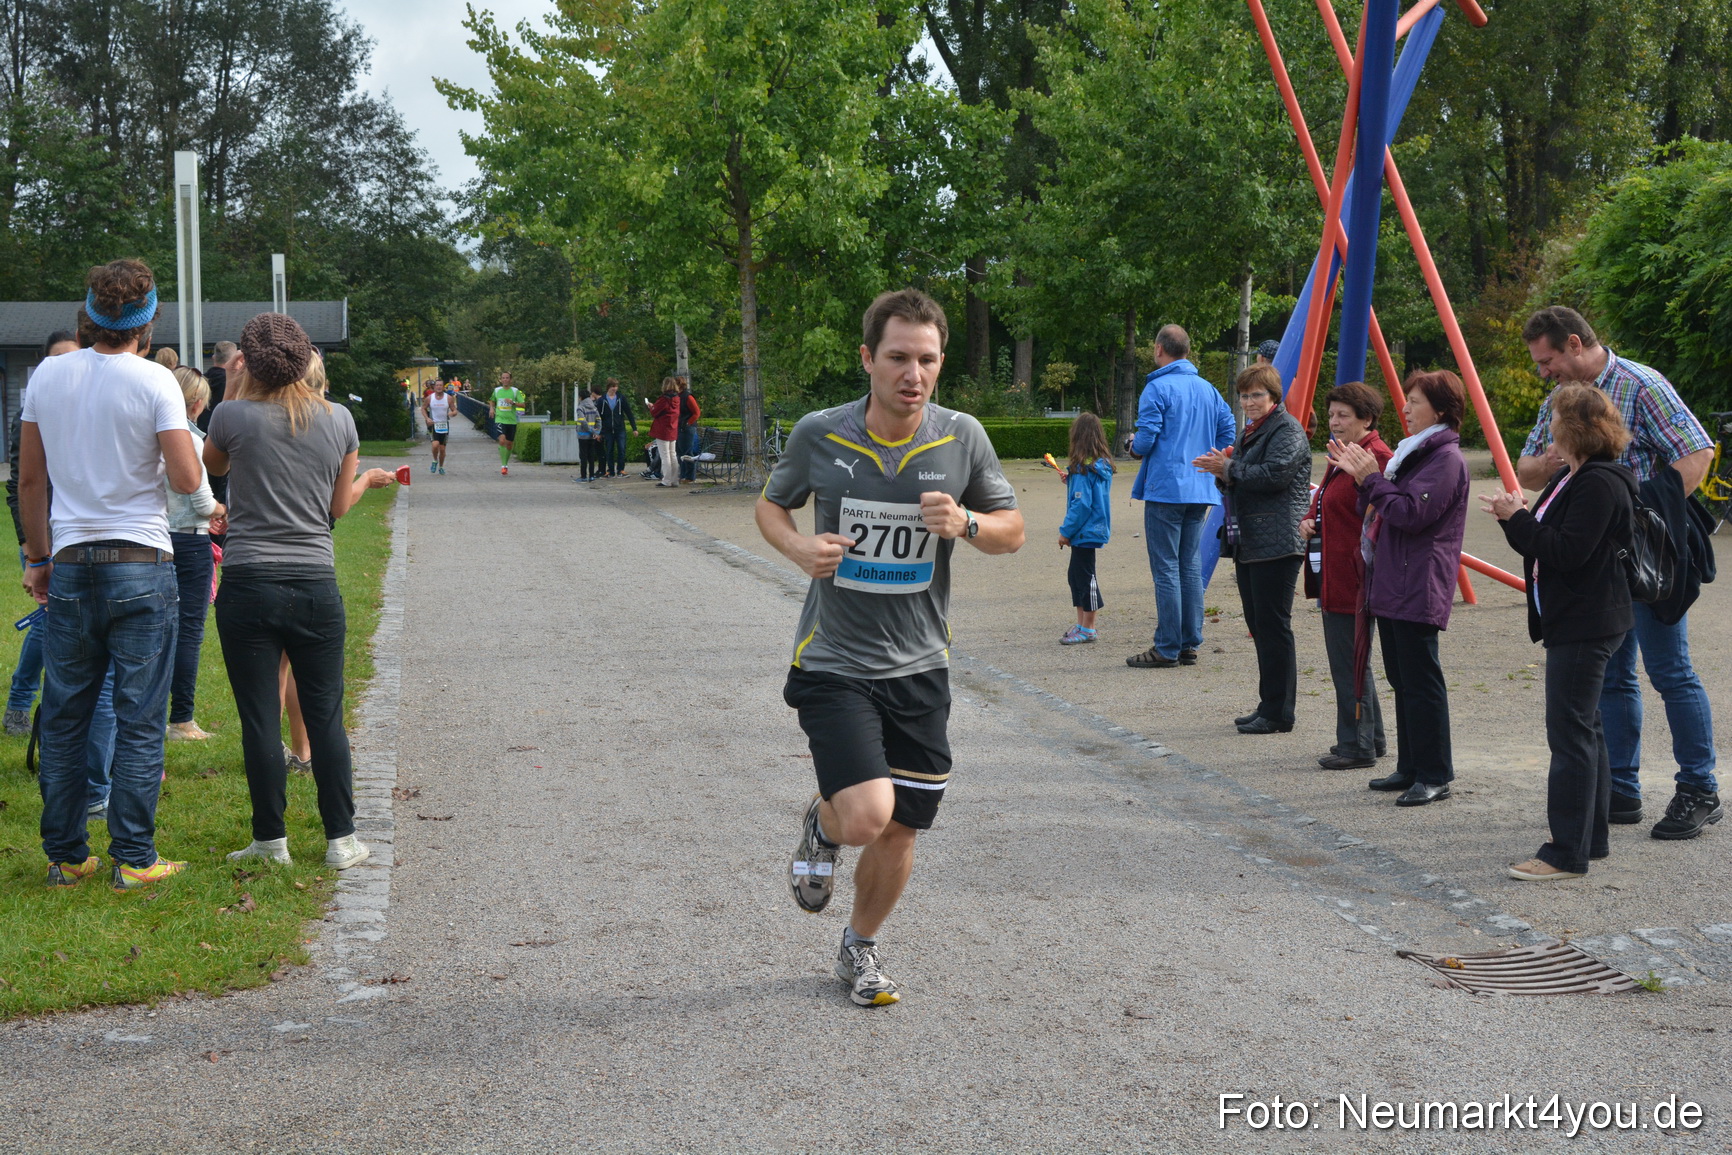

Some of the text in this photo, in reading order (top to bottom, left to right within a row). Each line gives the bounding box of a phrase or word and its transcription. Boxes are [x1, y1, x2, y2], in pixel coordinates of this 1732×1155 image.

[918, 471, 946, 480] kicker
[842, 507, 877, 519] PARTL
[848, 523, 931, 559] 2707
[854, 565, 917, 581] Johannes
